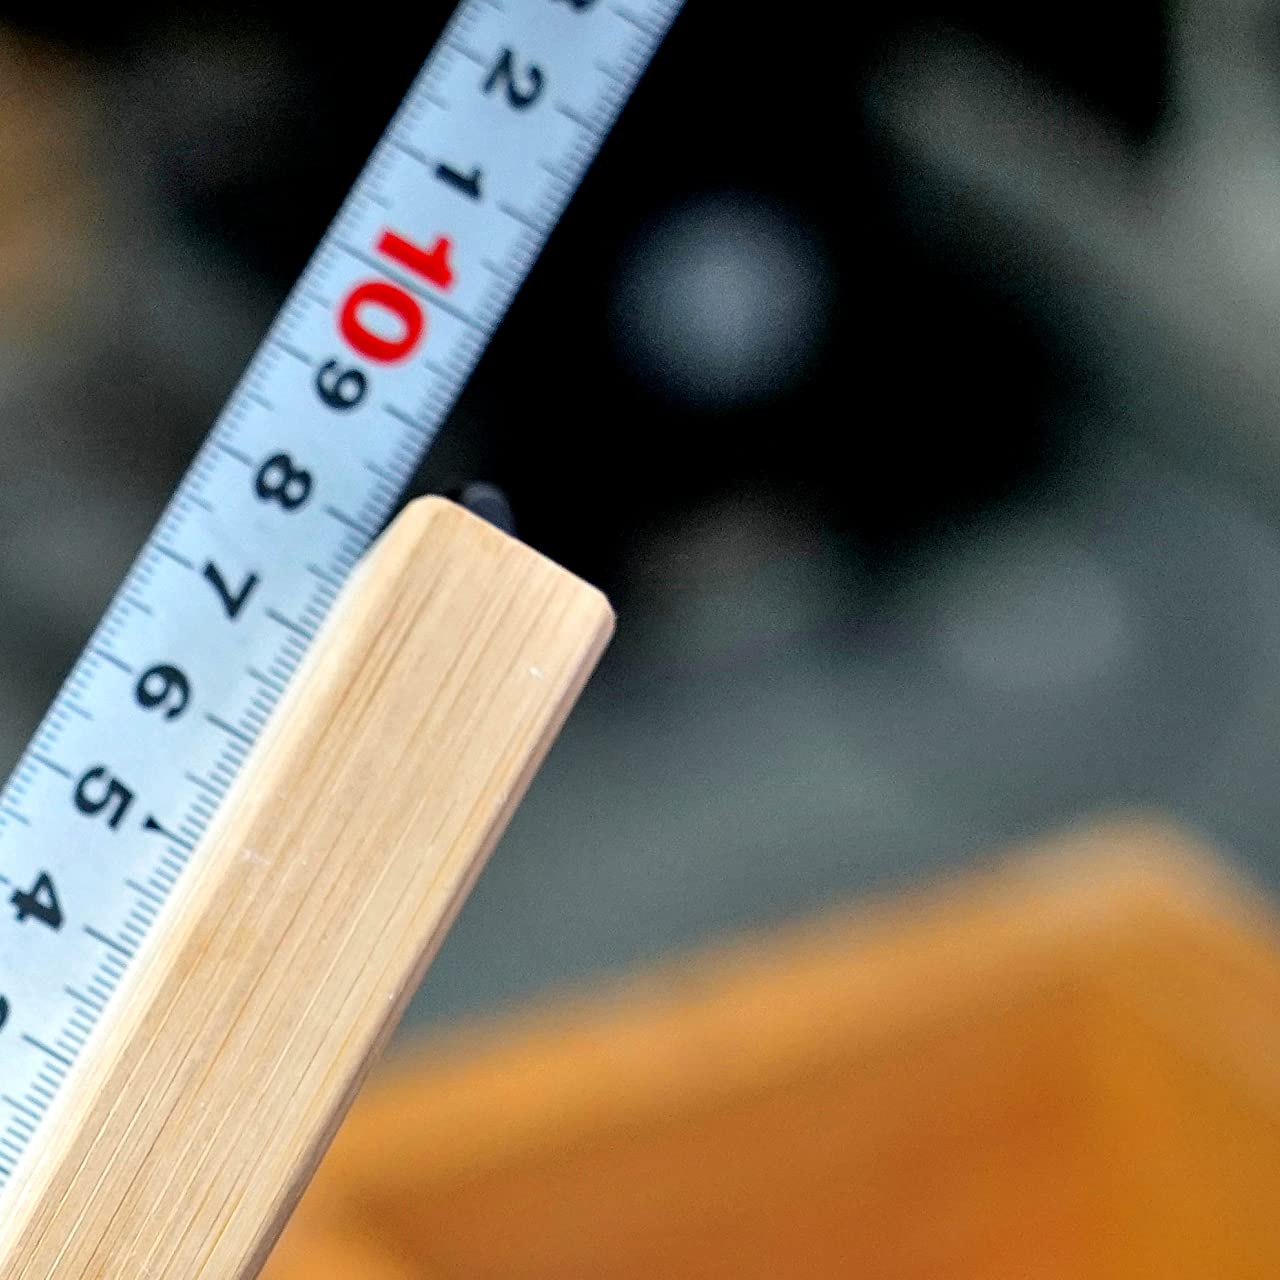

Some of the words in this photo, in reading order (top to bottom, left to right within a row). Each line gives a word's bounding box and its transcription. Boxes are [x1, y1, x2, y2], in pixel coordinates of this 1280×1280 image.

[482, 46, 546, 112] 2
[434, 162, 483, 201] 1
[335, 228, 456, 367] 10
[314, 358, 369, 412] 9
[253, 452, 314, 512] 8
[202, 561, 259, 620] 7
[134, 663, 191, 720] 6
[73, 765, 135, 830] 5
[9, 872, 64, 930] 4
